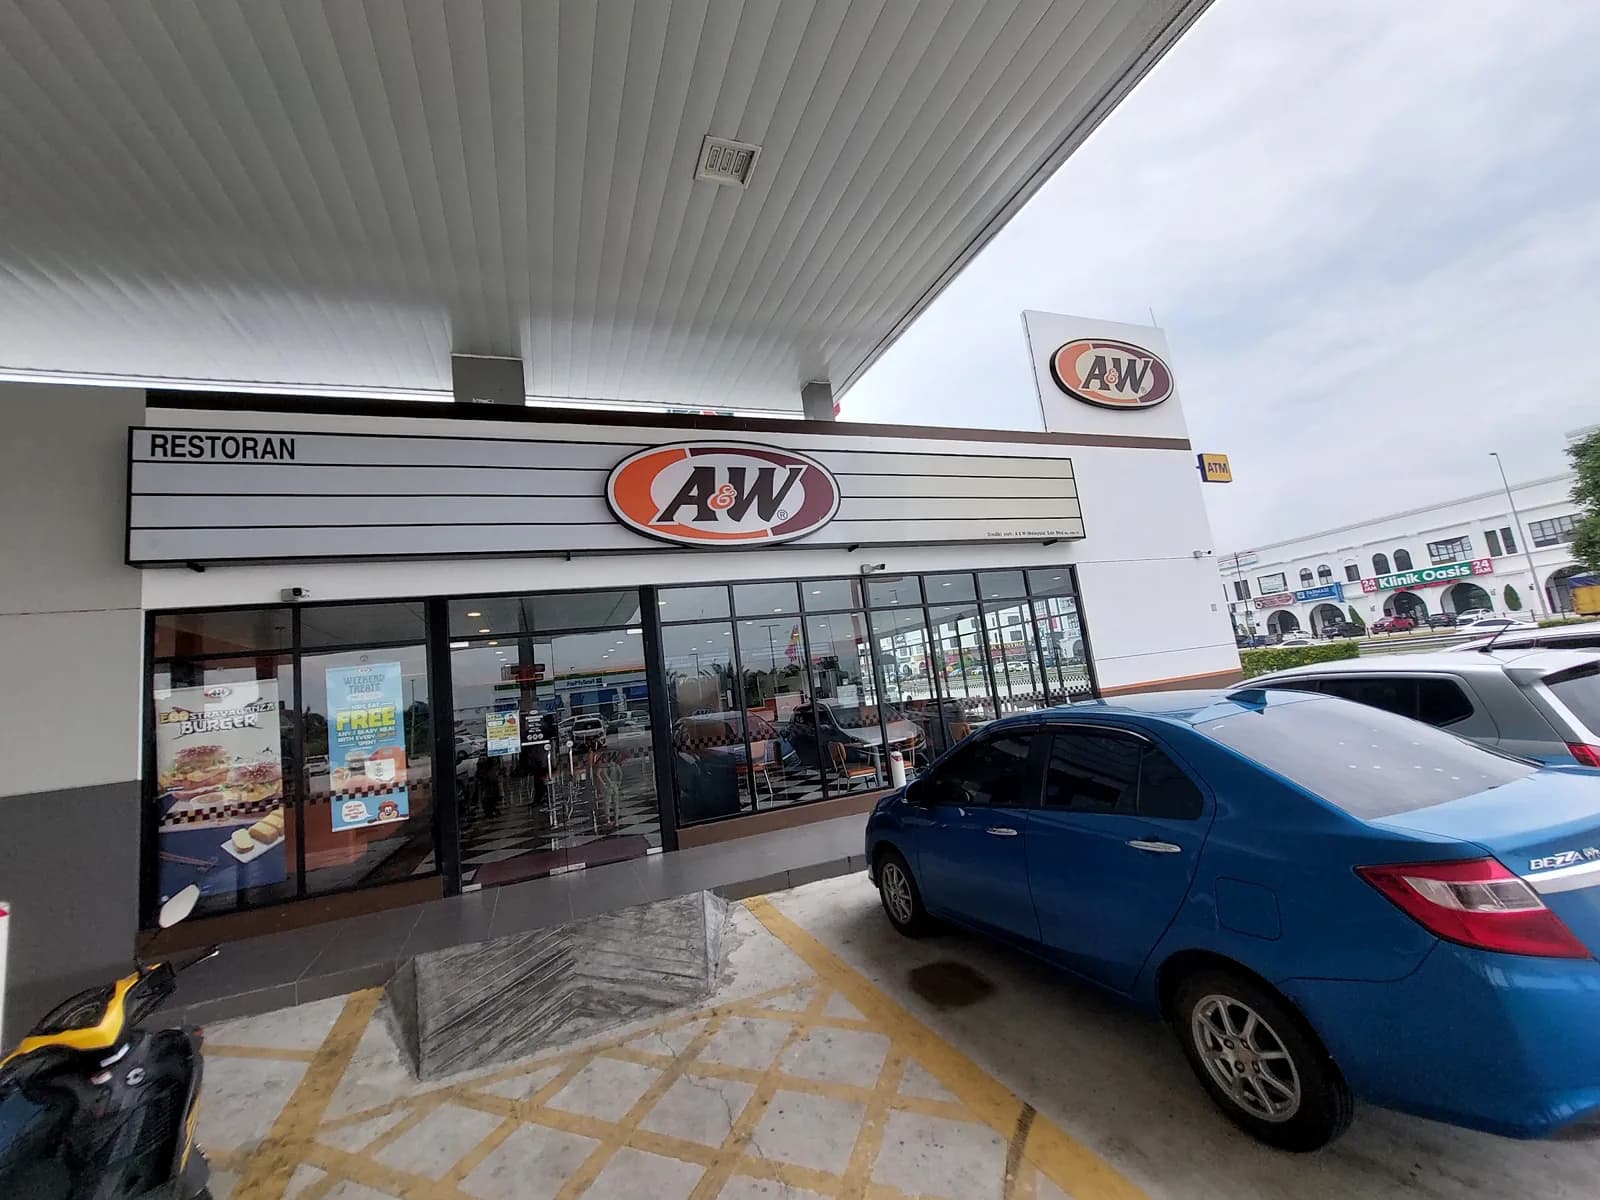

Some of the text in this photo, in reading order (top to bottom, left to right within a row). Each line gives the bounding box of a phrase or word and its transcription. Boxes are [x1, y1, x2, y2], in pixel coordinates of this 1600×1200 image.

[1081, 355, 1151, 393] A&W
[150, 434, 295, 460] RESTORAN
[1207, 462, 1229, 474] ATM
[656, 467, 804, 522] A&W
[1473, 560, 1490, 569] 24
[1475, 566, 1492, 574] JAM
[1379, 565, 1471, 588] Klinik Oasis
[343, 673, 385, 685] WEEKEND
[180, 714, 257, 734] BURGER
[336, 706, 396, 731] FREE
[1530, 850, 1584, 870] BEZZA
